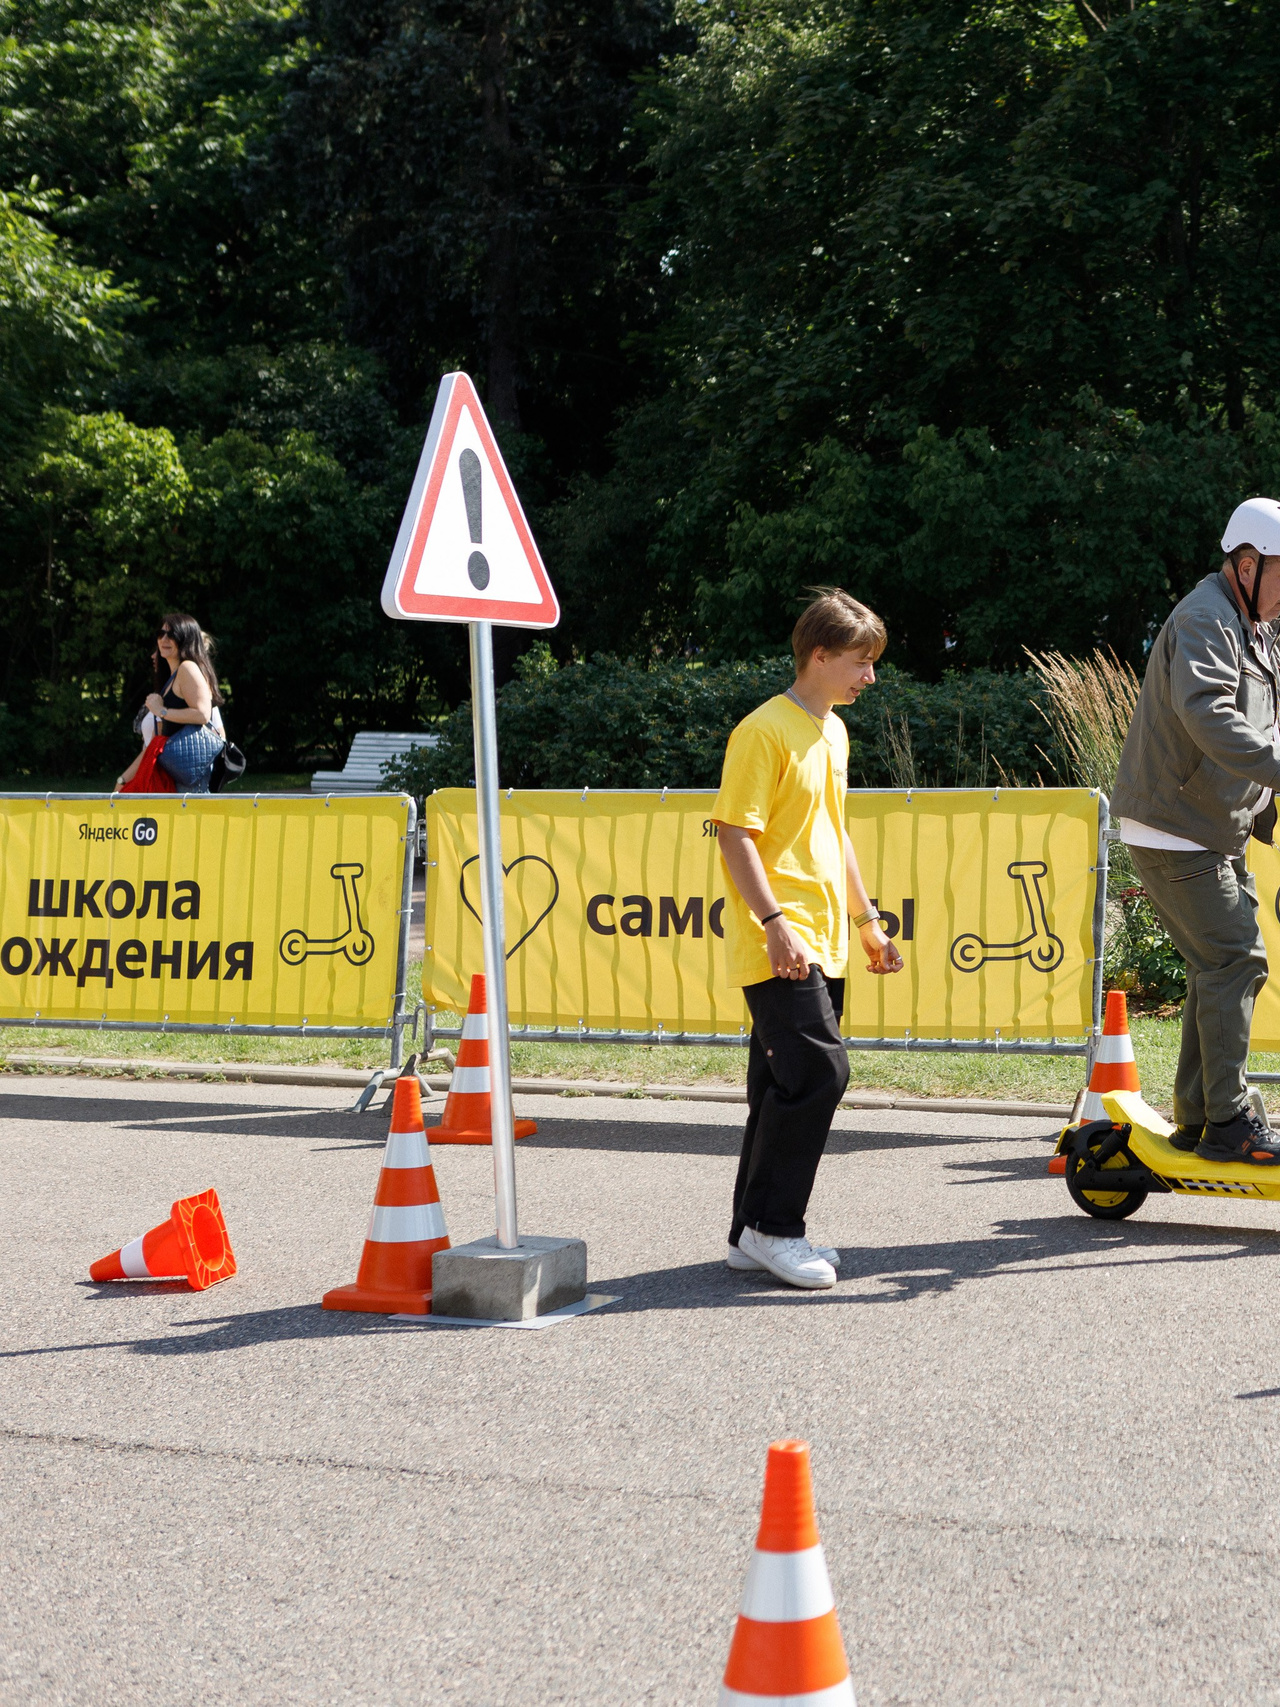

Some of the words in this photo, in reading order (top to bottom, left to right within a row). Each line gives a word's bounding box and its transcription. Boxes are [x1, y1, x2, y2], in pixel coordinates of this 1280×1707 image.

[79, 823, 129, 842] Яндекс
[134, 822, 156, 841] Go
[28, 878, 200, 920] школа
